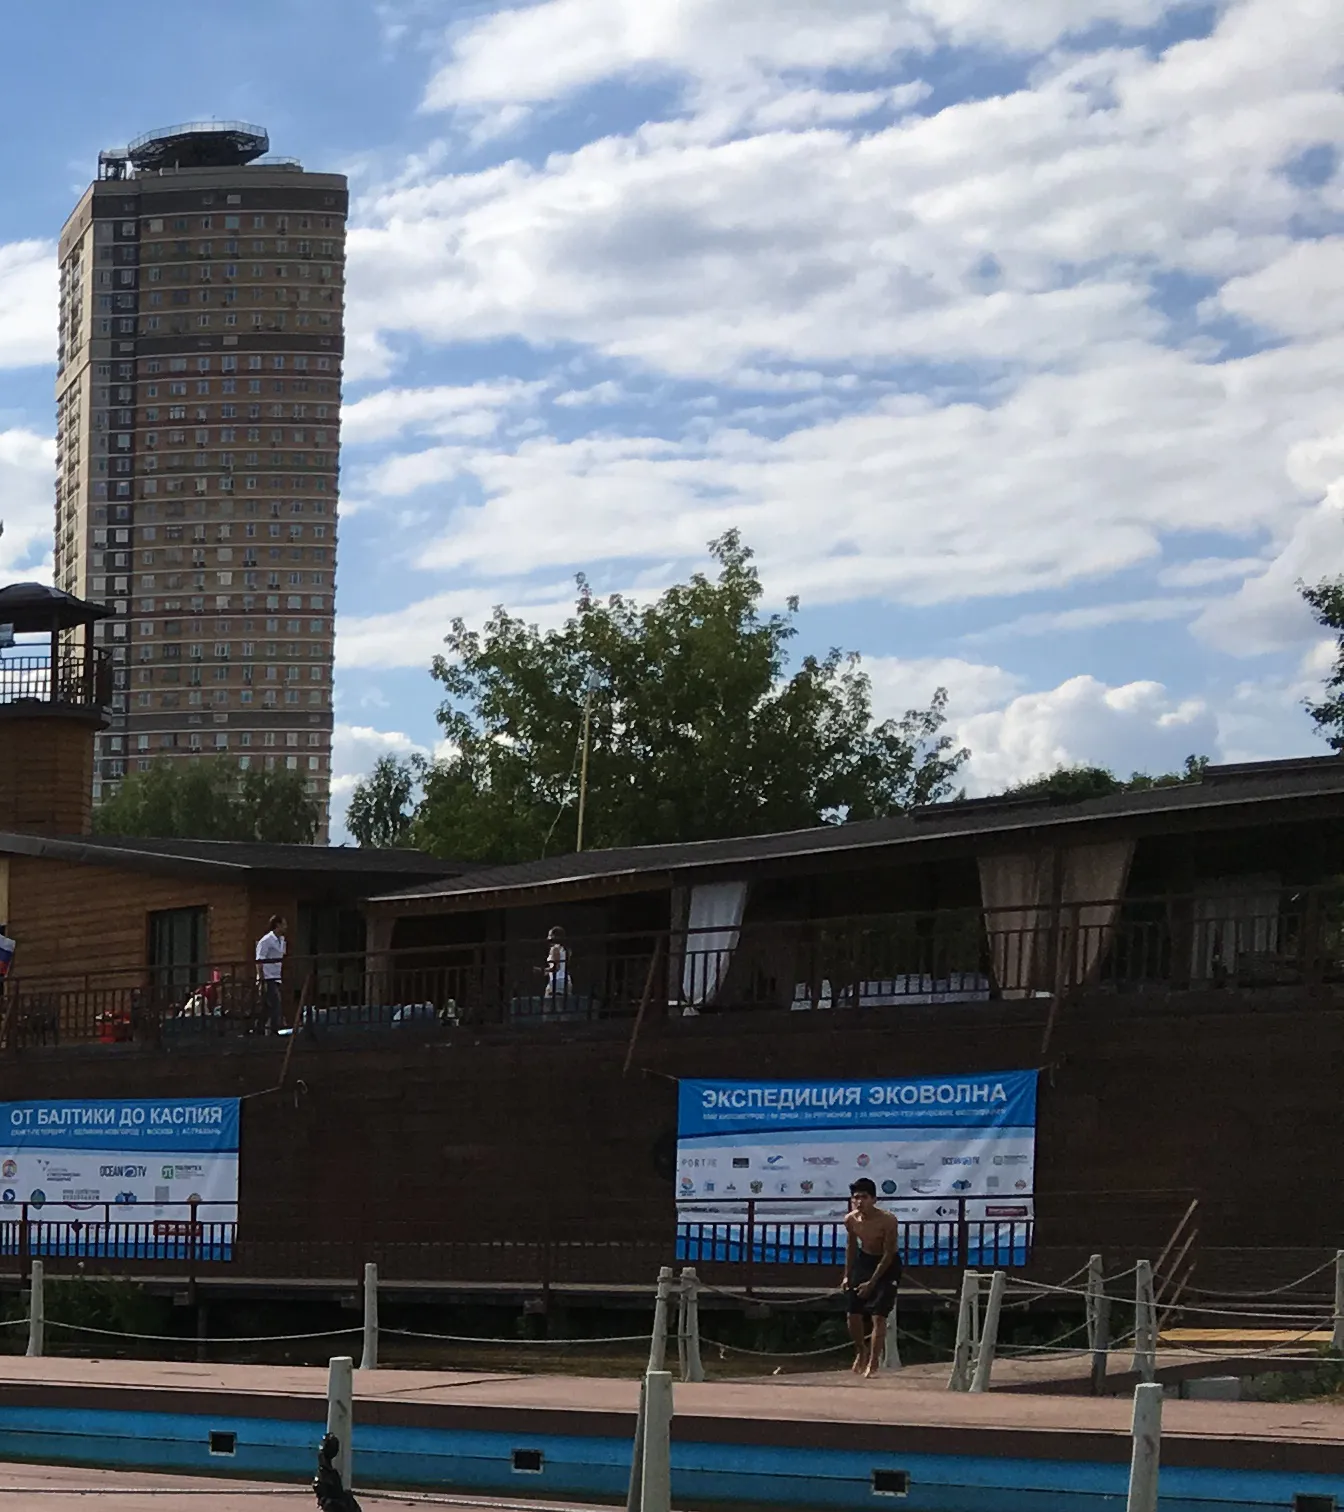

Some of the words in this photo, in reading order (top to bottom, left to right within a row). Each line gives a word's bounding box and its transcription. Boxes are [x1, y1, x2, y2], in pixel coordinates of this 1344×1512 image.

[702, 1087, 861, 1110] ЭКСПЕДИЦИЯ
[868, 1083, 1008, 1105] ЭКОВОЛНА
[11, 1109, 32, 1125] ОТ
[37, 1108, 115, 1125] БАЛТИКИ
[119, 1108, 145, 1126] ДО
[150, 1106, 223, 1124] КАСПИЯ
[100, 1165, 123, 1177] OCEAN
[137, 1165, 148, 1177] TV
